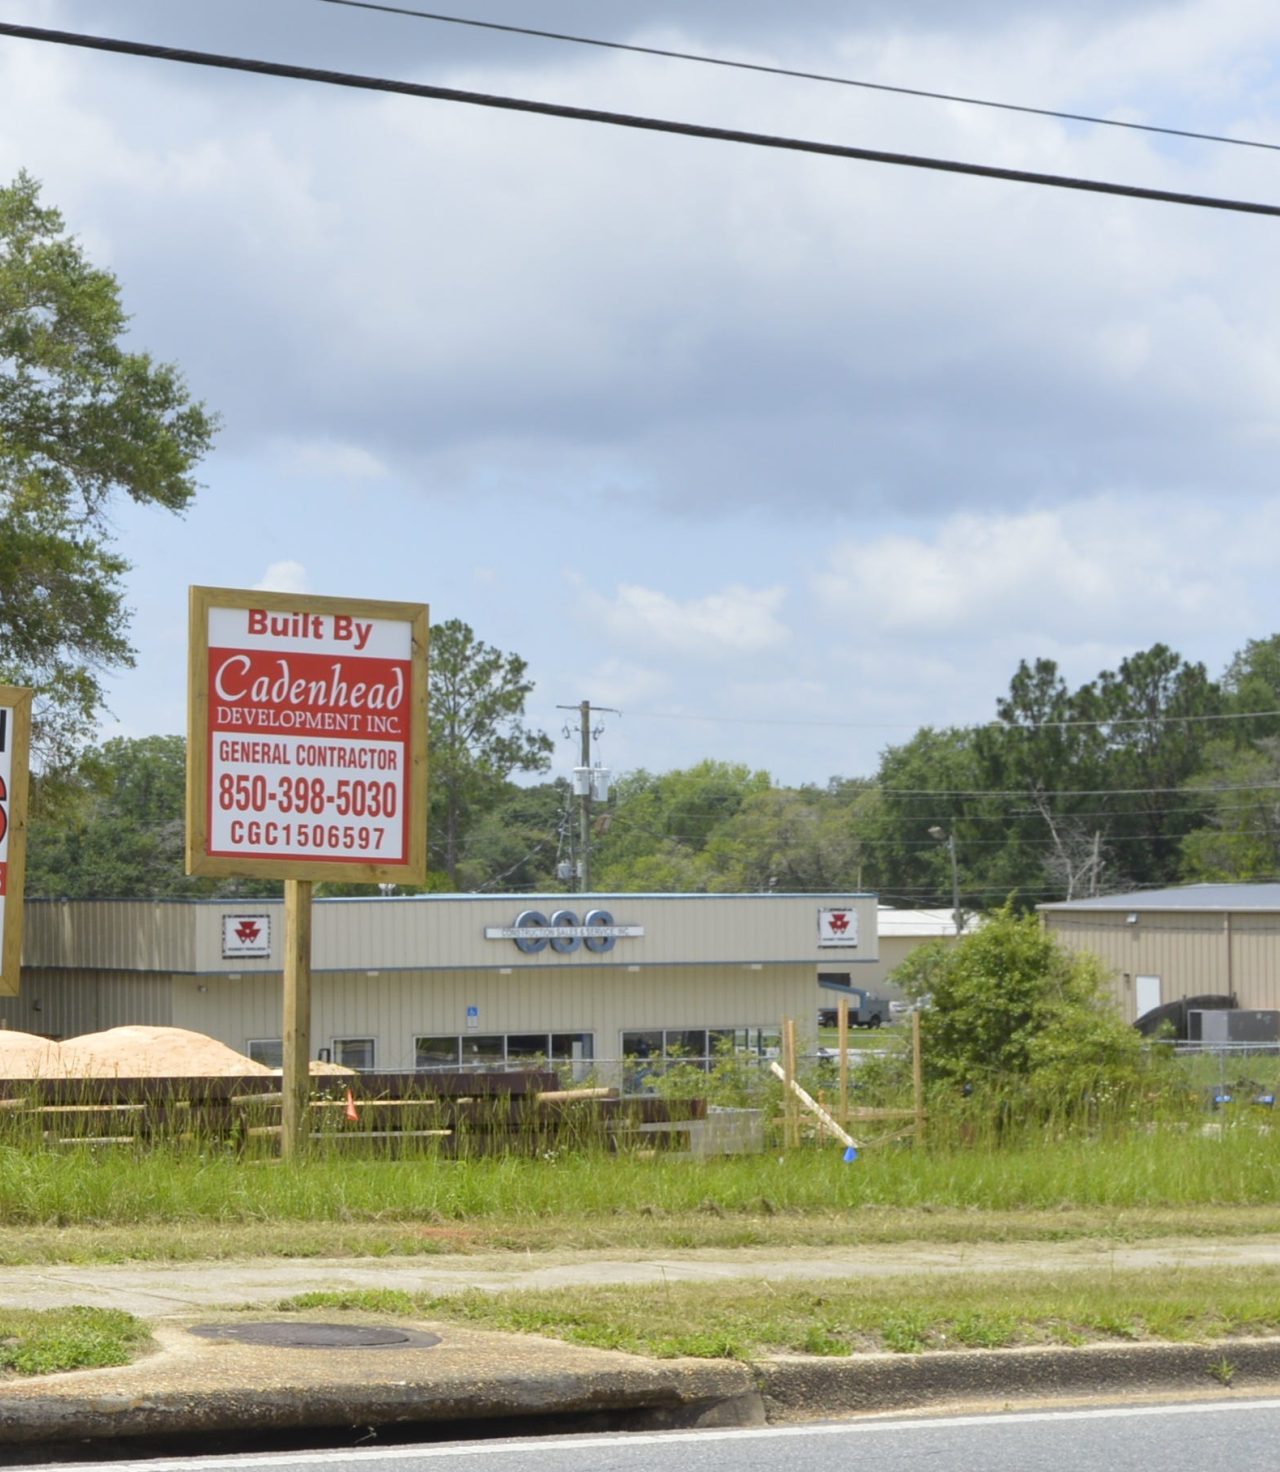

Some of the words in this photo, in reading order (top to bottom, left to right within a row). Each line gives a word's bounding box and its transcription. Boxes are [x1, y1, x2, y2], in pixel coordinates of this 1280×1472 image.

[248, 608, 323, 640] Built
[333, 615, 373, 650] By
[215, 654, 404, 710] Cadenhead
[217, 706, 361, 732] DEVELOPMENT
[220, 740, 290, 765] GENERAL
[296, 744, 397, 770] CONTRACTOR
[219, 773, 396, 818] 850-398-5030
[231, 820, 385, 850] CGC1506597
